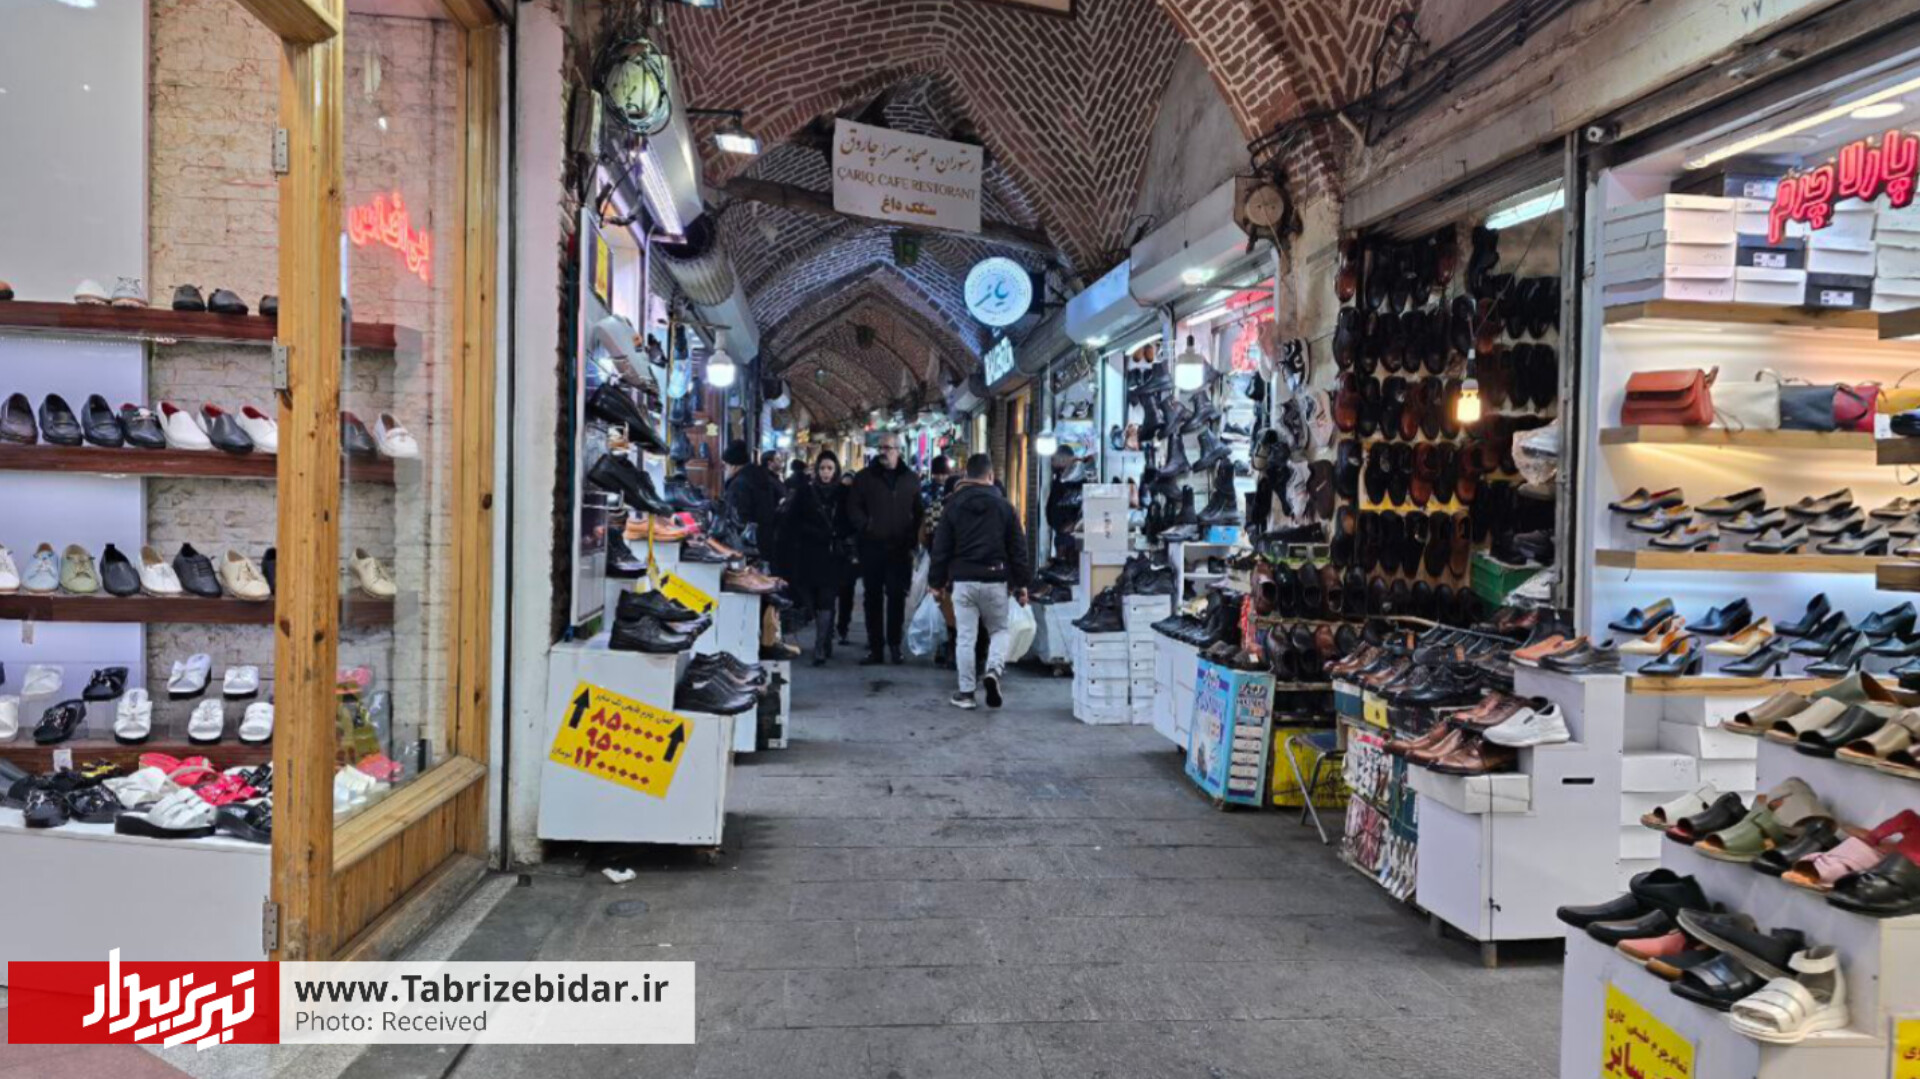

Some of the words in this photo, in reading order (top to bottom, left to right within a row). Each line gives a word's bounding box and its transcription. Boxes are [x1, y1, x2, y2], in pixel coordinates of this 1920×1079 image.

[934, 148, 976, 174] رستوران
[878, 173, 909, 191] CAFE
[911, 179, 977, 201] RESTORANT
[881, 194, 902, 214] داغ
[1767, 164, 1834, 244] چرم
